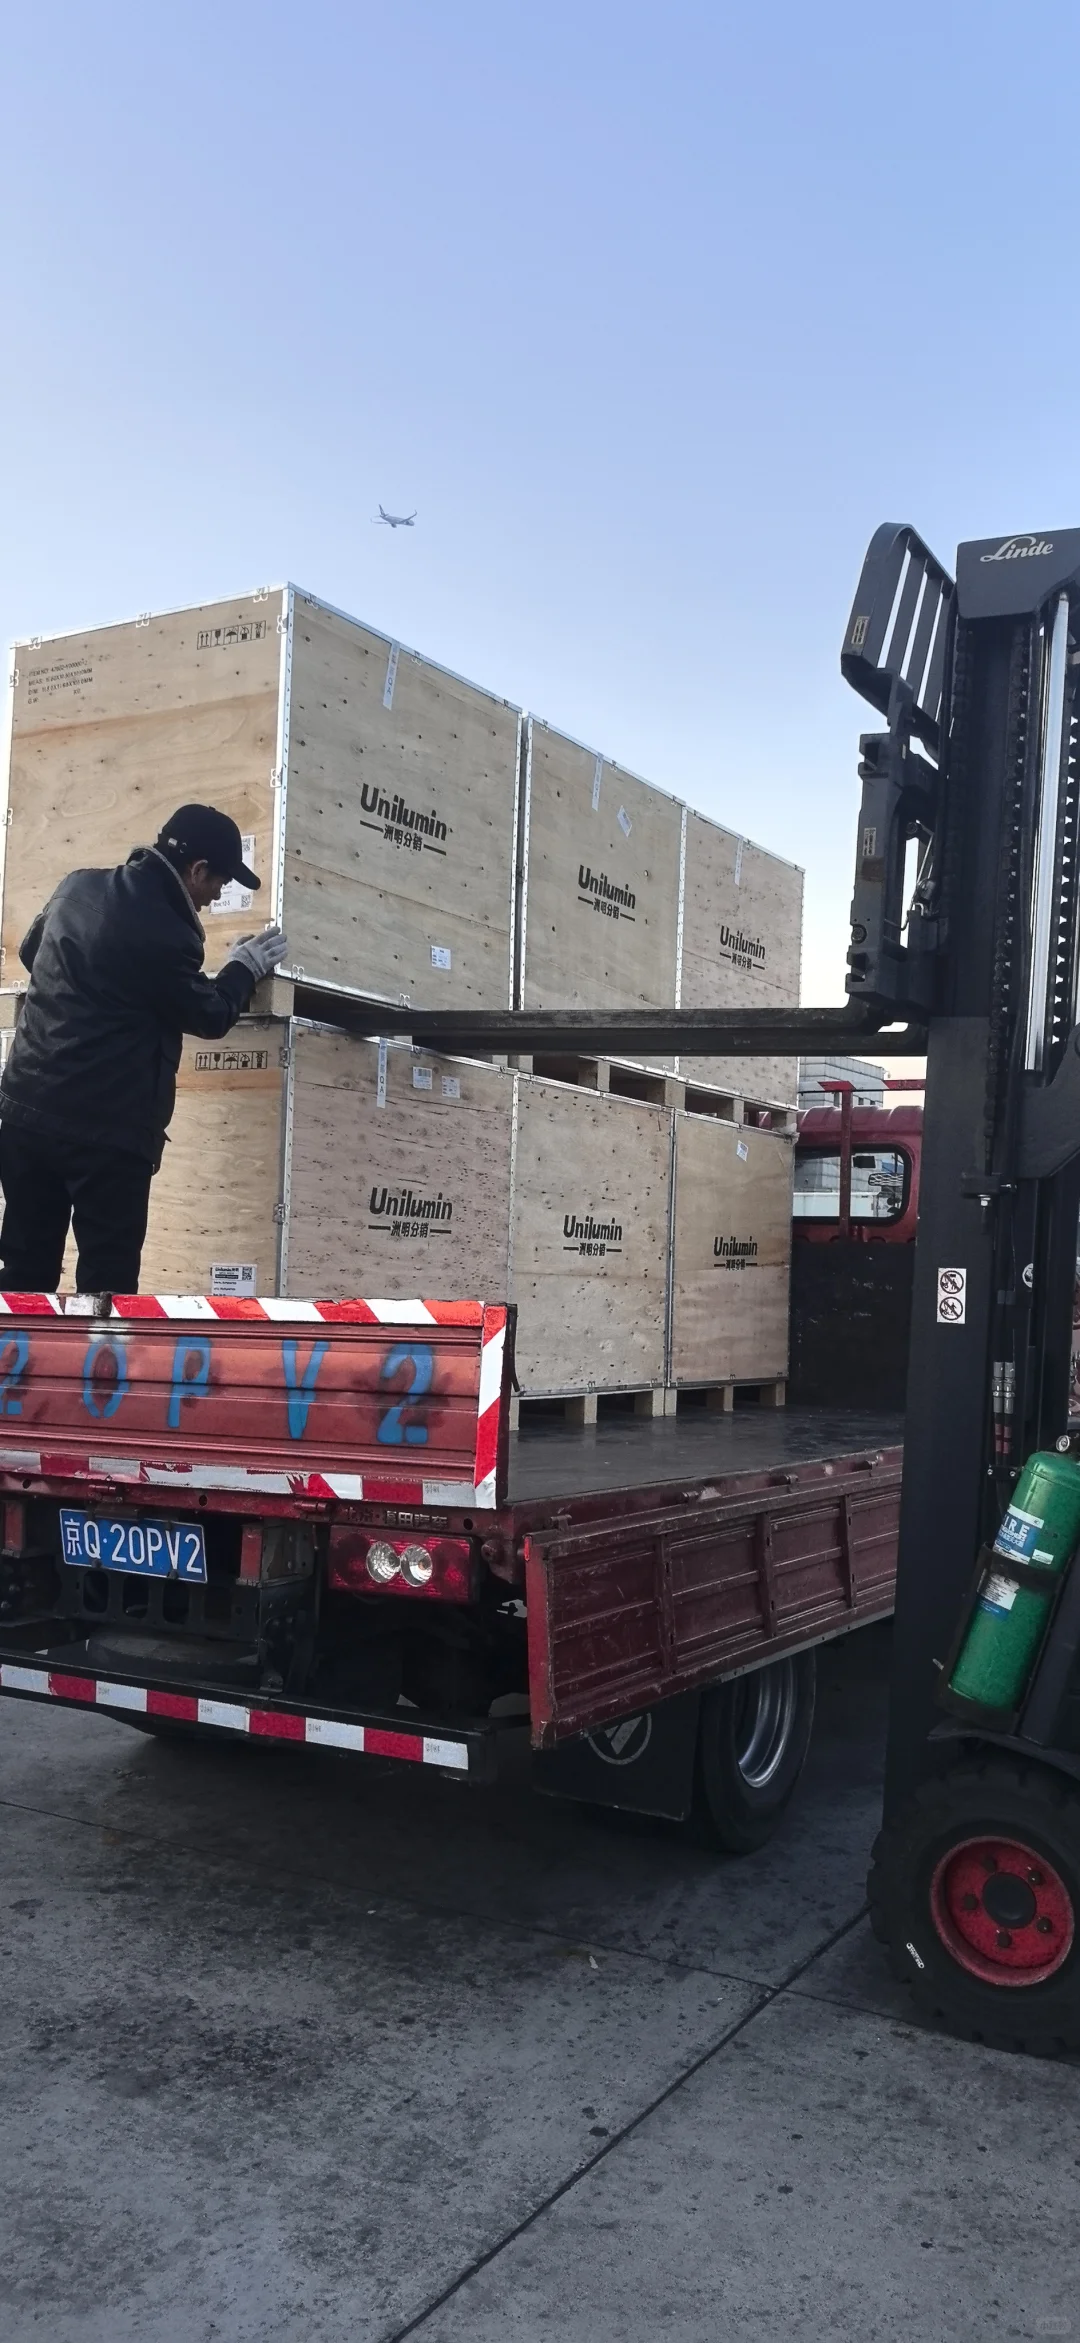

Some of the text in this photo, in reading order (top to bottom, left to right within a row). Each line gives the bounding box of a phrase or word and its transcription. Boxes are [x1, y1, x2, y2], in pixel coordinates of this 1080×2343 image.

[980, 536, 1054, 562] Linde
[361, 783, 447, 841] Unilumin
[578, 864, 636, 909] Unilumin
[720, 925, 766, 960] Unilumin
[369, 1187, 453, 1220] Unilumin
[563, 1215, 622, 1241] Unilumin
[713, 1236, 758, 1257] Unilumin
